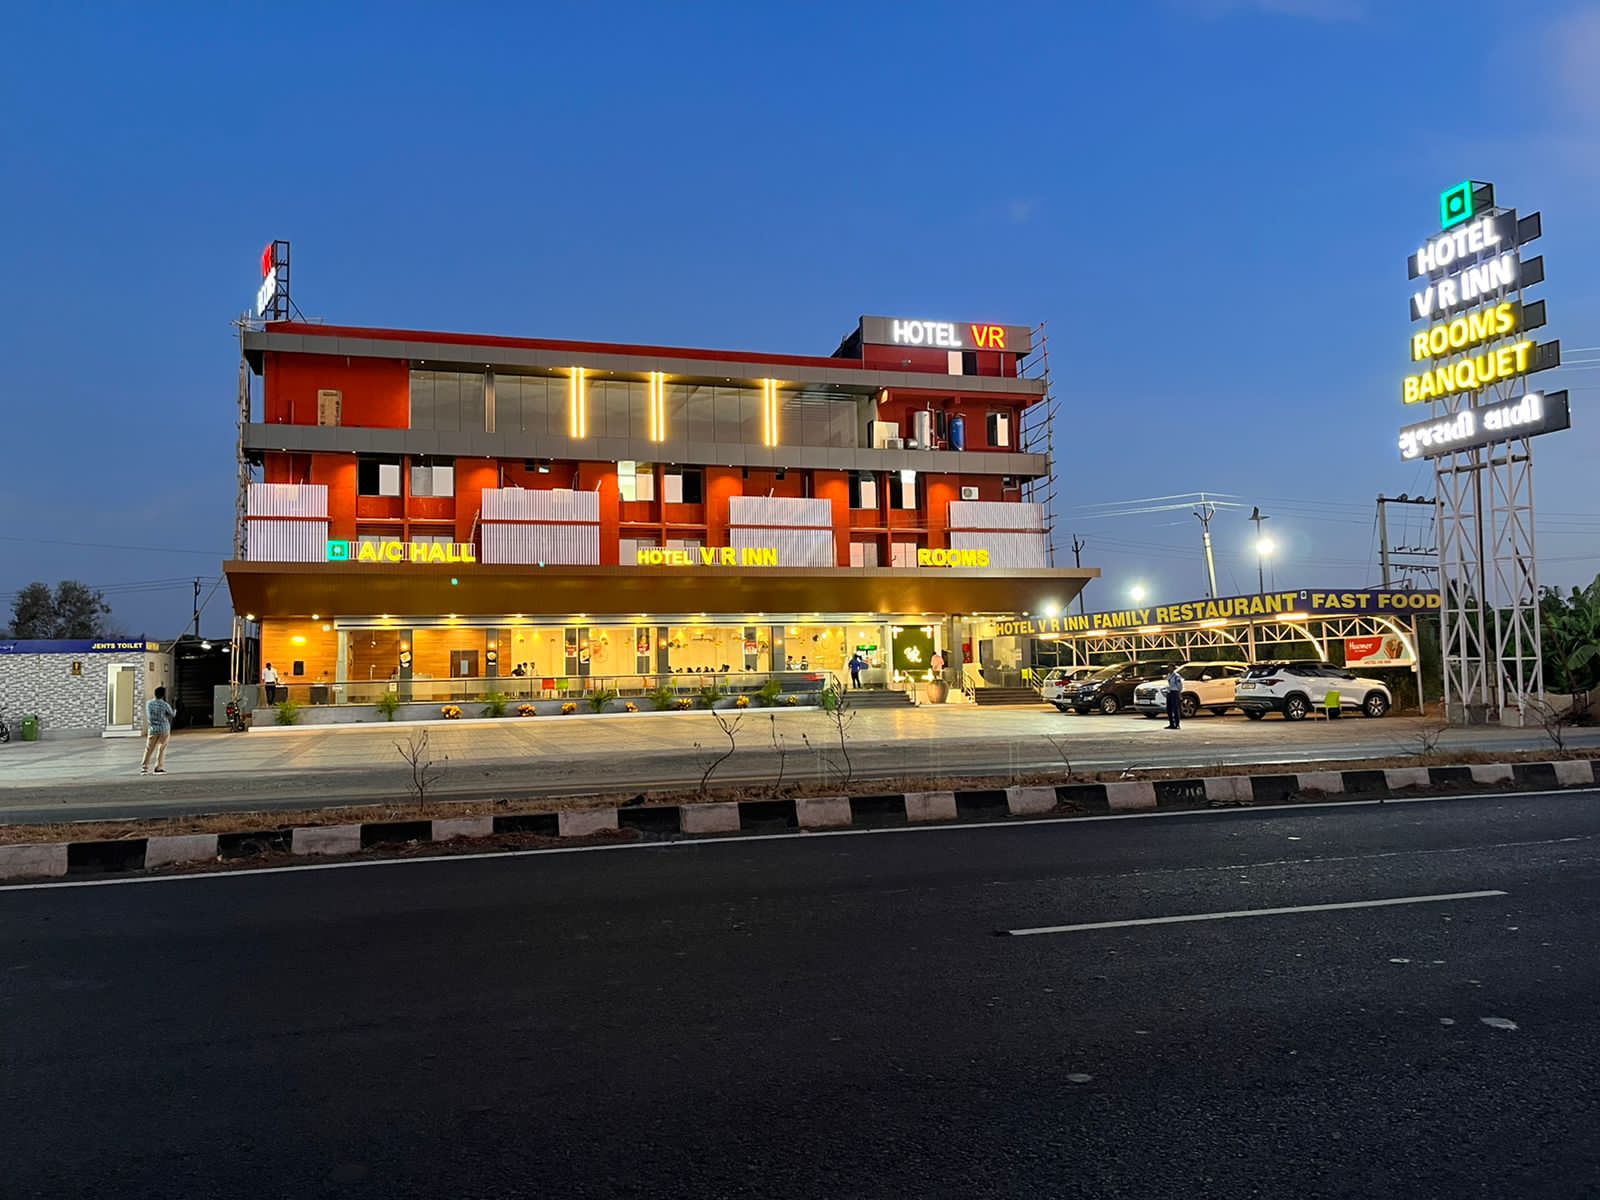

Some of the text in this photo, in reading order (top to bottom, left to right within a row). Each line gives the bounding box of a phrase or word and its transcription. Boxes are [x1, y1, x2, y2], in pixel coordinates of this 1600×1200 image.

[1417, 219, 1501, 275] HOTEL
[1414, 255, 1512, 317] V R INN
[894, 319, 1005, 349] HOTEL VR
[1414, 304, 1514, 360] ROOMS
[1404, 342, 1531, 404] BANQUET
[358, 541, 476, 563] A/C HALL
[637, 547, 777, 566] HOTEL V R INN
[918, 548, 990, 567] ROOMS
[996, 592, 1441, 636] HOTEL V R INN FAMILY RESTAURANT FAST FOOD
